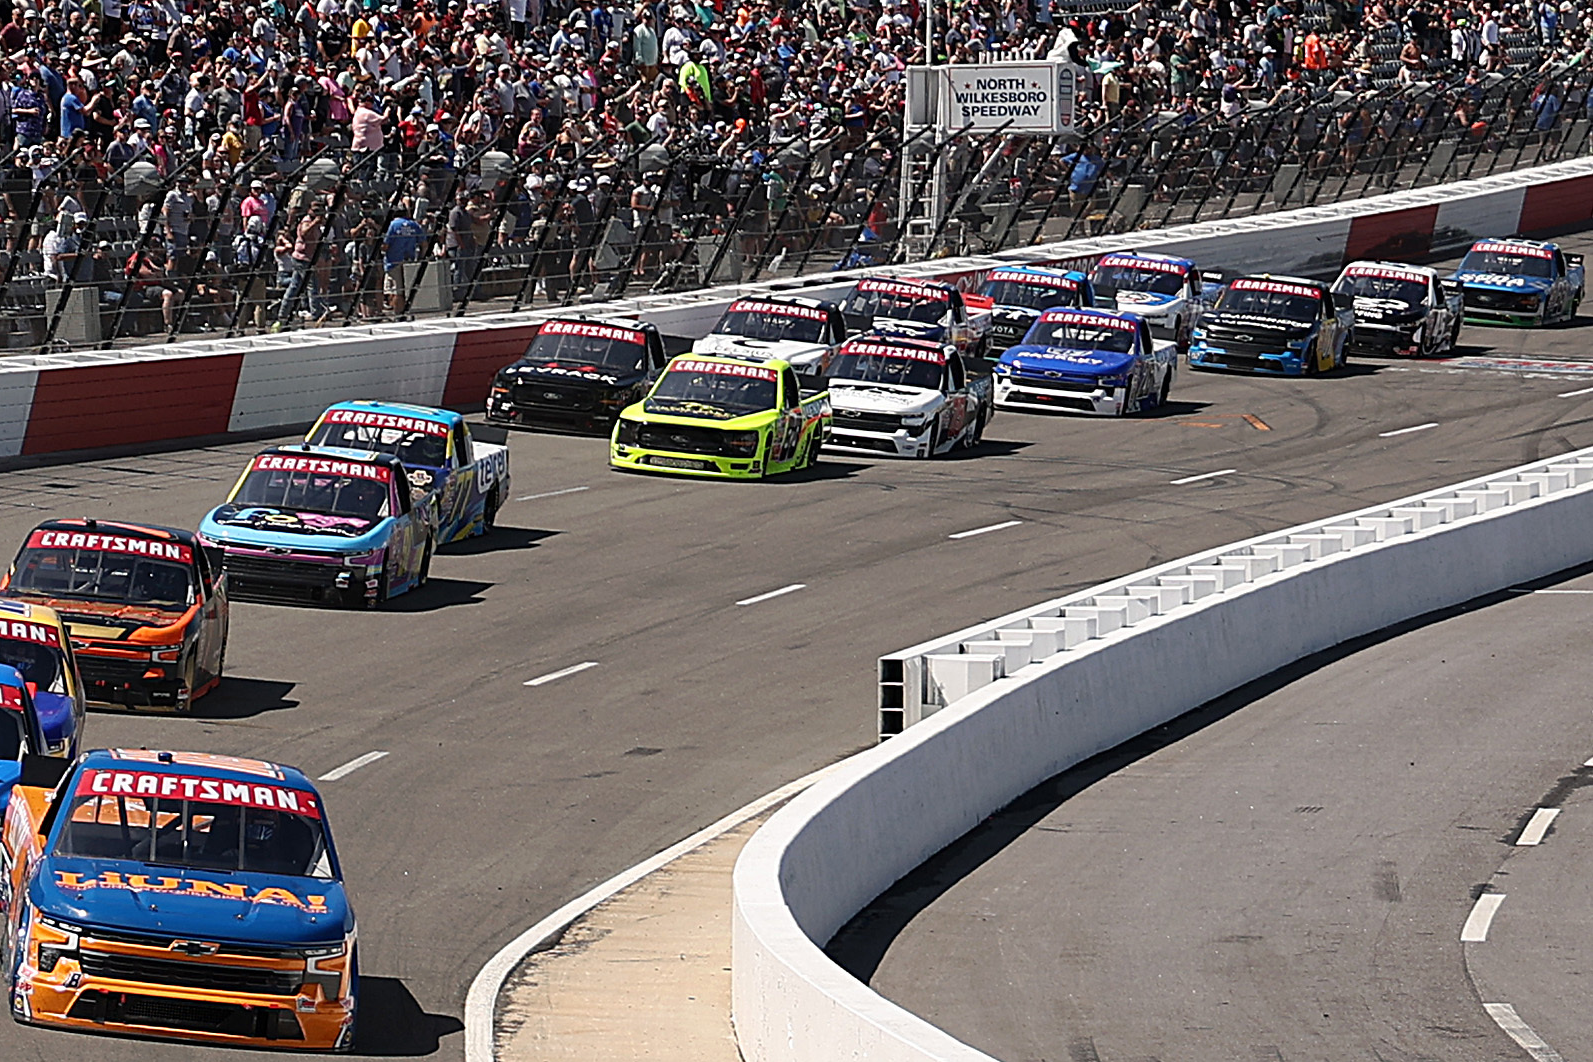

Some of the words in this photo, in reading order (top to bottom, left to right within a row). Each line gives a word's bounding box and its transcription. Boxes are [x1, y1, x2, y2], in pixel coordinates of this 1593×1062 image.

[976, 78, 1026, 90] NORTH
[956, 91, 1047, 103] WILKESBORO
[961, 105, 1041, 117] SPEEDWAY
[1476, 243, 1545, 258] CRAFTSMAN
[1105, 257, 1179, 273] CRAFTSMAN
[1349, 266, 1424, 282] CRAFTSMAN
[994, 271, 1071, 289] CRAFTSMAN
[1235, 280, 1313, 297] CRAFTSMAN
[861, 281, 942, 300] CRAFTSMAN
[736, 301, 820, 320] CRAFTSMAN
[1047, 312, 1131, 330] CRAFTSMAN
[543, 322, 635, 342] CRAFTSMAN
[849, 343, 939, 362] CRAFTSMAN
[674, 360, 769, 379] CRAFTSMAN
[331, 410, 442, 434] CRAFTSMAN
[257, 456, 379, 480] CRAFTSMAN
[40, 531, 181, 559] CRAFTSMAN
[92, 771, 302, 811] CRAFTSMAN
